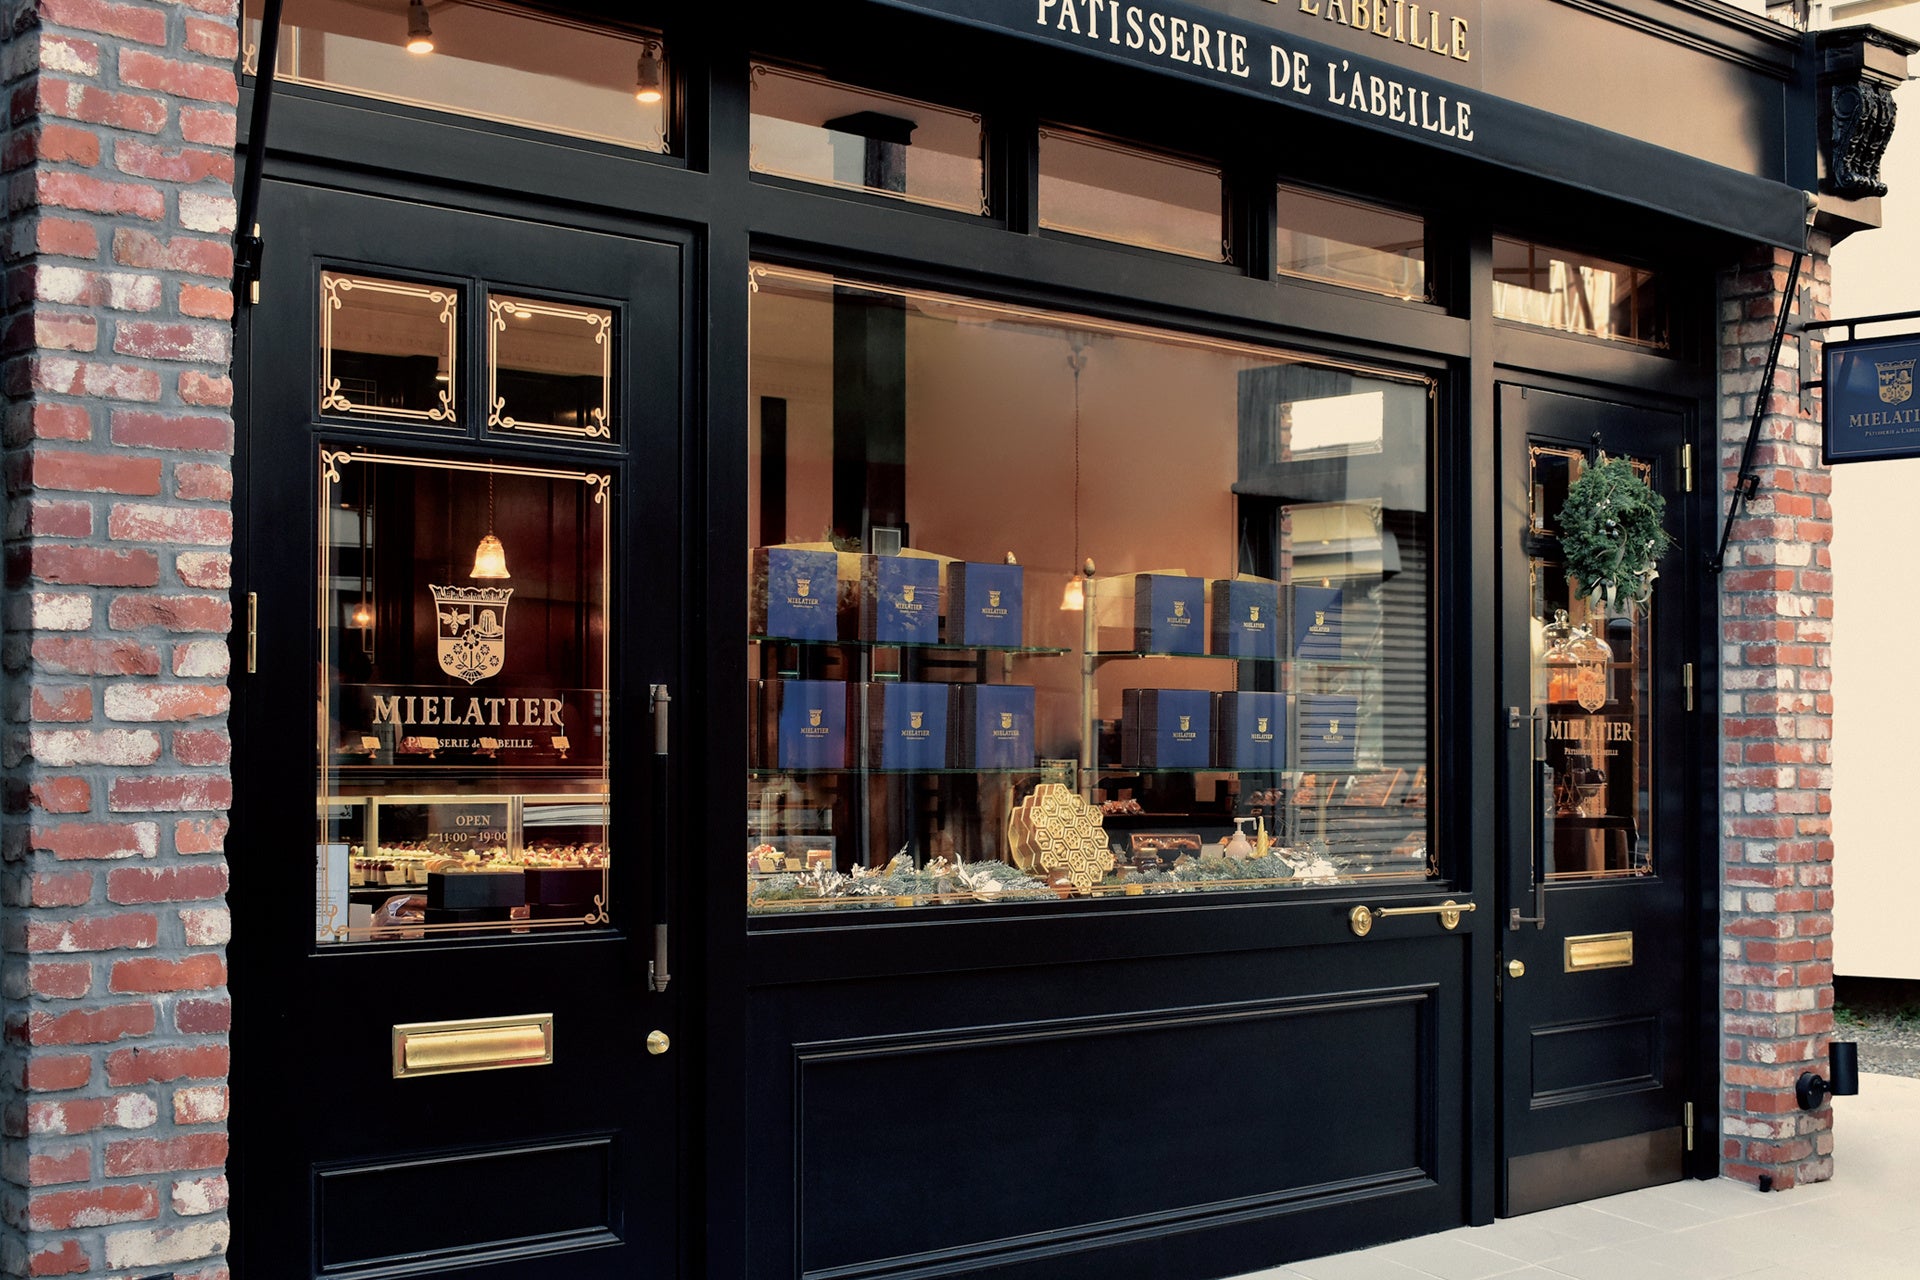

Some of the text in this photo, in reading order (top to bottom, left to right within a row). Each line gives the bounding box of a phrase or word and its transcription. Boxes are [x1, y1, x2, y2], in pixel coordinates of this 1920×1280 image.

[1037, 0, 1474, 141] PATISSERIE DE L'ABEILLE
[373, 695, 565, 726] MIELATIER
[1549, 720, 1632, 741] MIELATIER
[407, 736, 469, 748] PASERIE
[456, 815, 491, 826] OPEN
